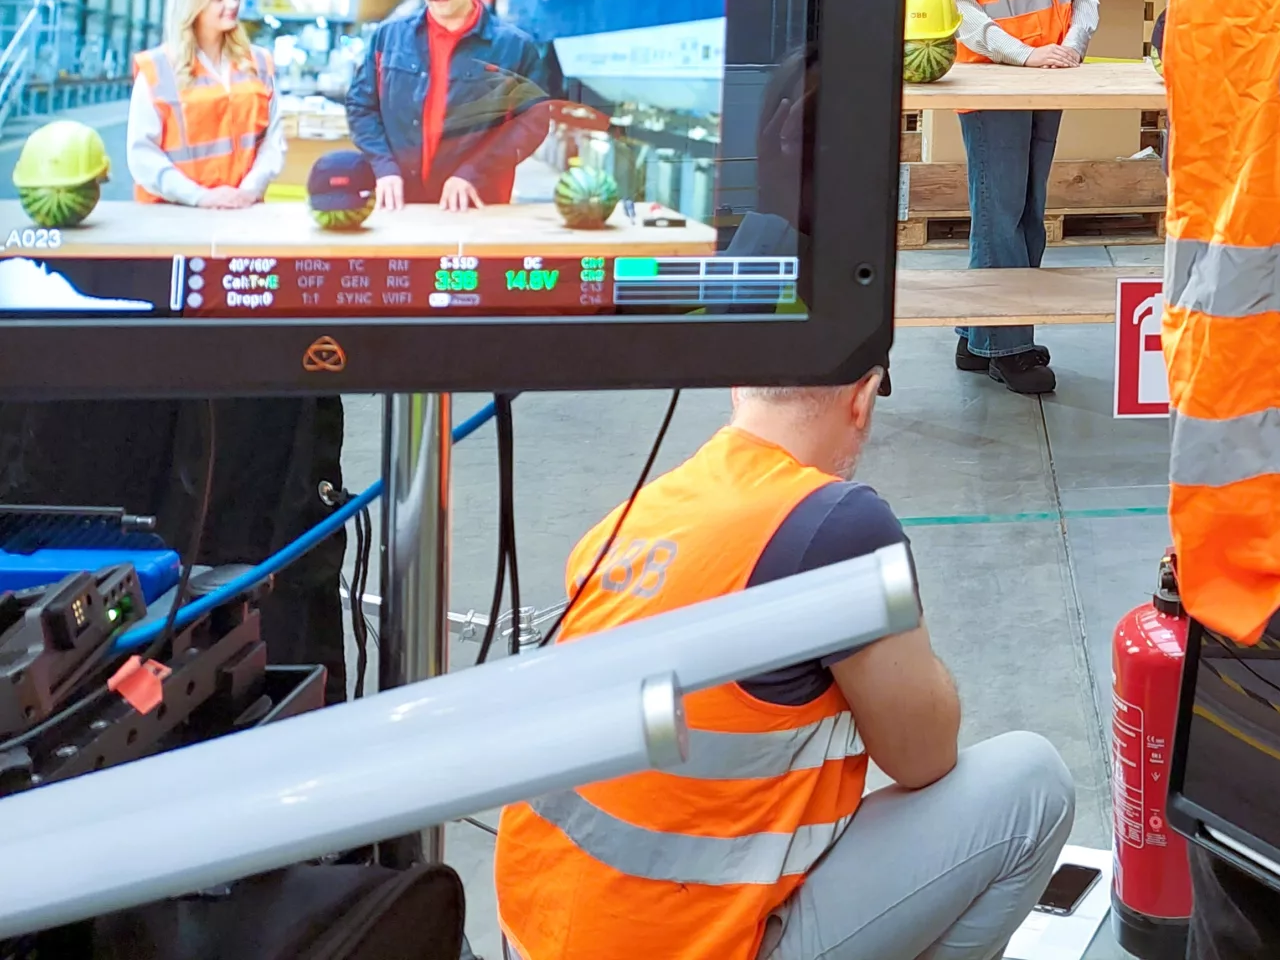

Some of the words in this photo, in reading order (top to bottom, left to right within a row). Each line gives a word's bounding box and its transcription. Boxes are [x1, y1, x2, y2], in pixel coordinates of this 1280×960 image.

[297, 276, 324, 288] OFF
[341, 276, 370, 288] GEN
[336, 292, 372, 305] SYNC
